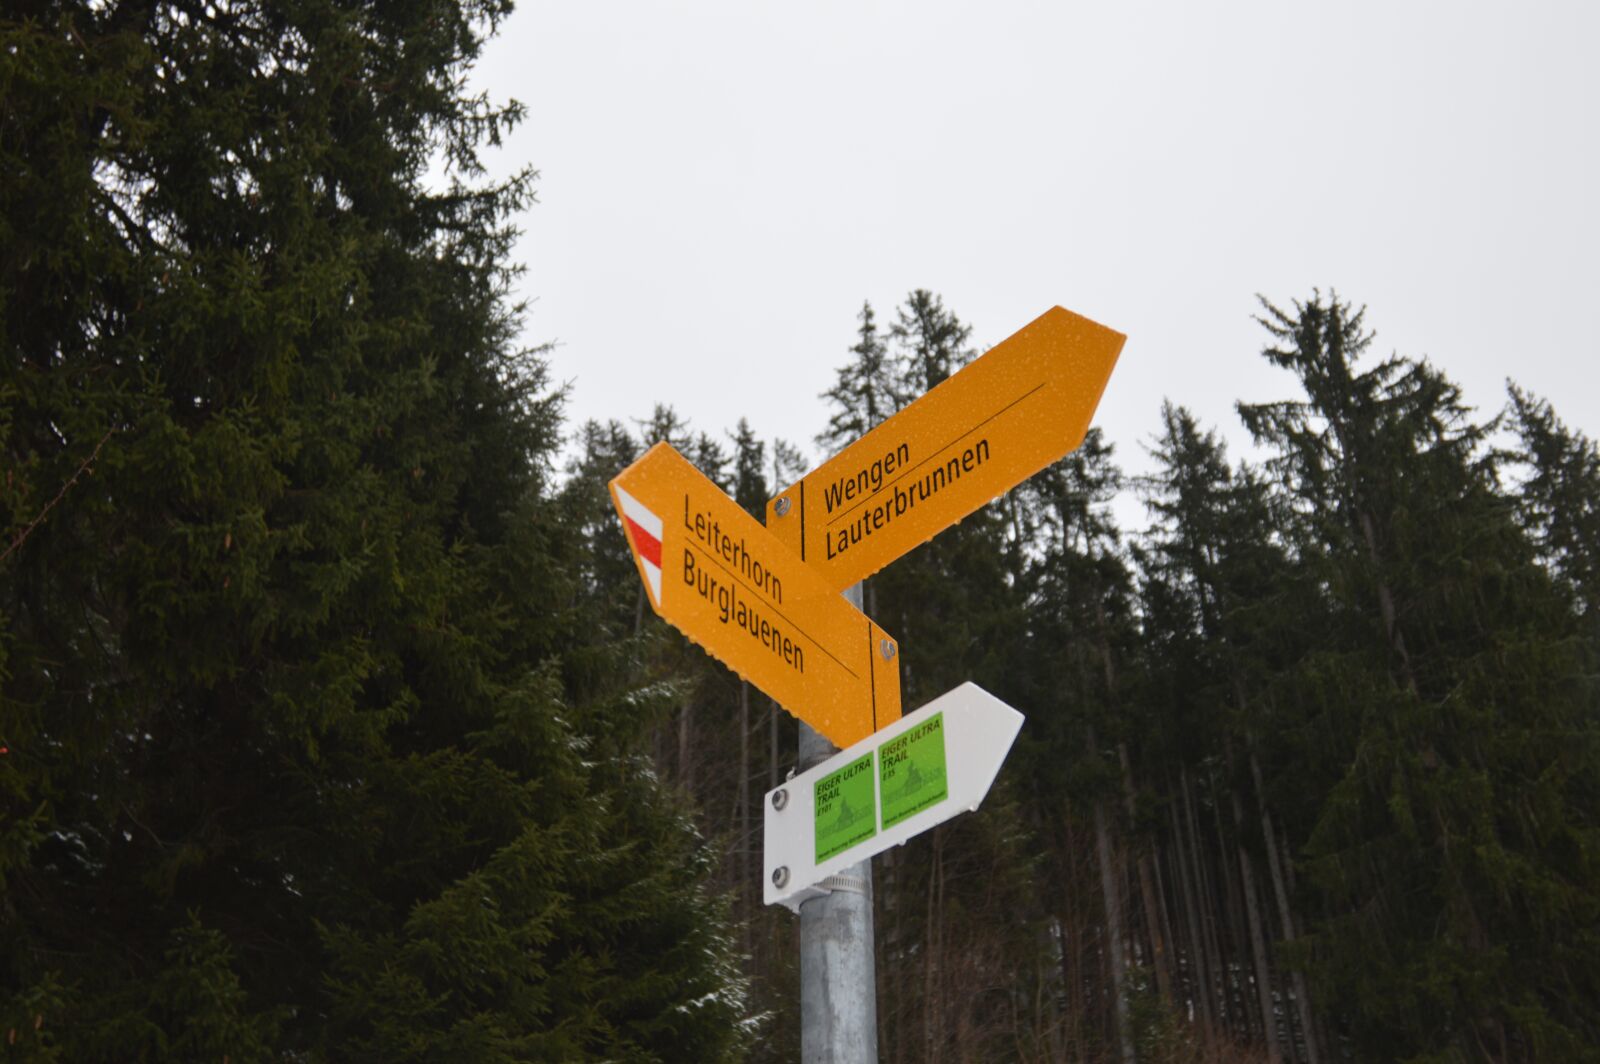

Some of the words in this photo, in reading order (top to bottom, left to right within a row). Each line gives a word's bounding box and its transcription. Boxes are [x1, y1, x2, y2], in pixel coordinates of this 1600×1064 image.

[824, 442, 909, 513] Wengen
[826, 438, 990, 560] Lauterbrunnen
[684, 493, 782, 604] Leiterhorn
[683, 549, 804, 673] Burglauenen
[882, 737, 907, 759] EIGER
[910, 720, 940, 742] ULTRA
[882, 750, 909, 770] TRAIL
[817, 774, 841, 795] EIGER
[843, 759, 871, 784] ULTRA
[817, 787, 840, 806] TRAIL
